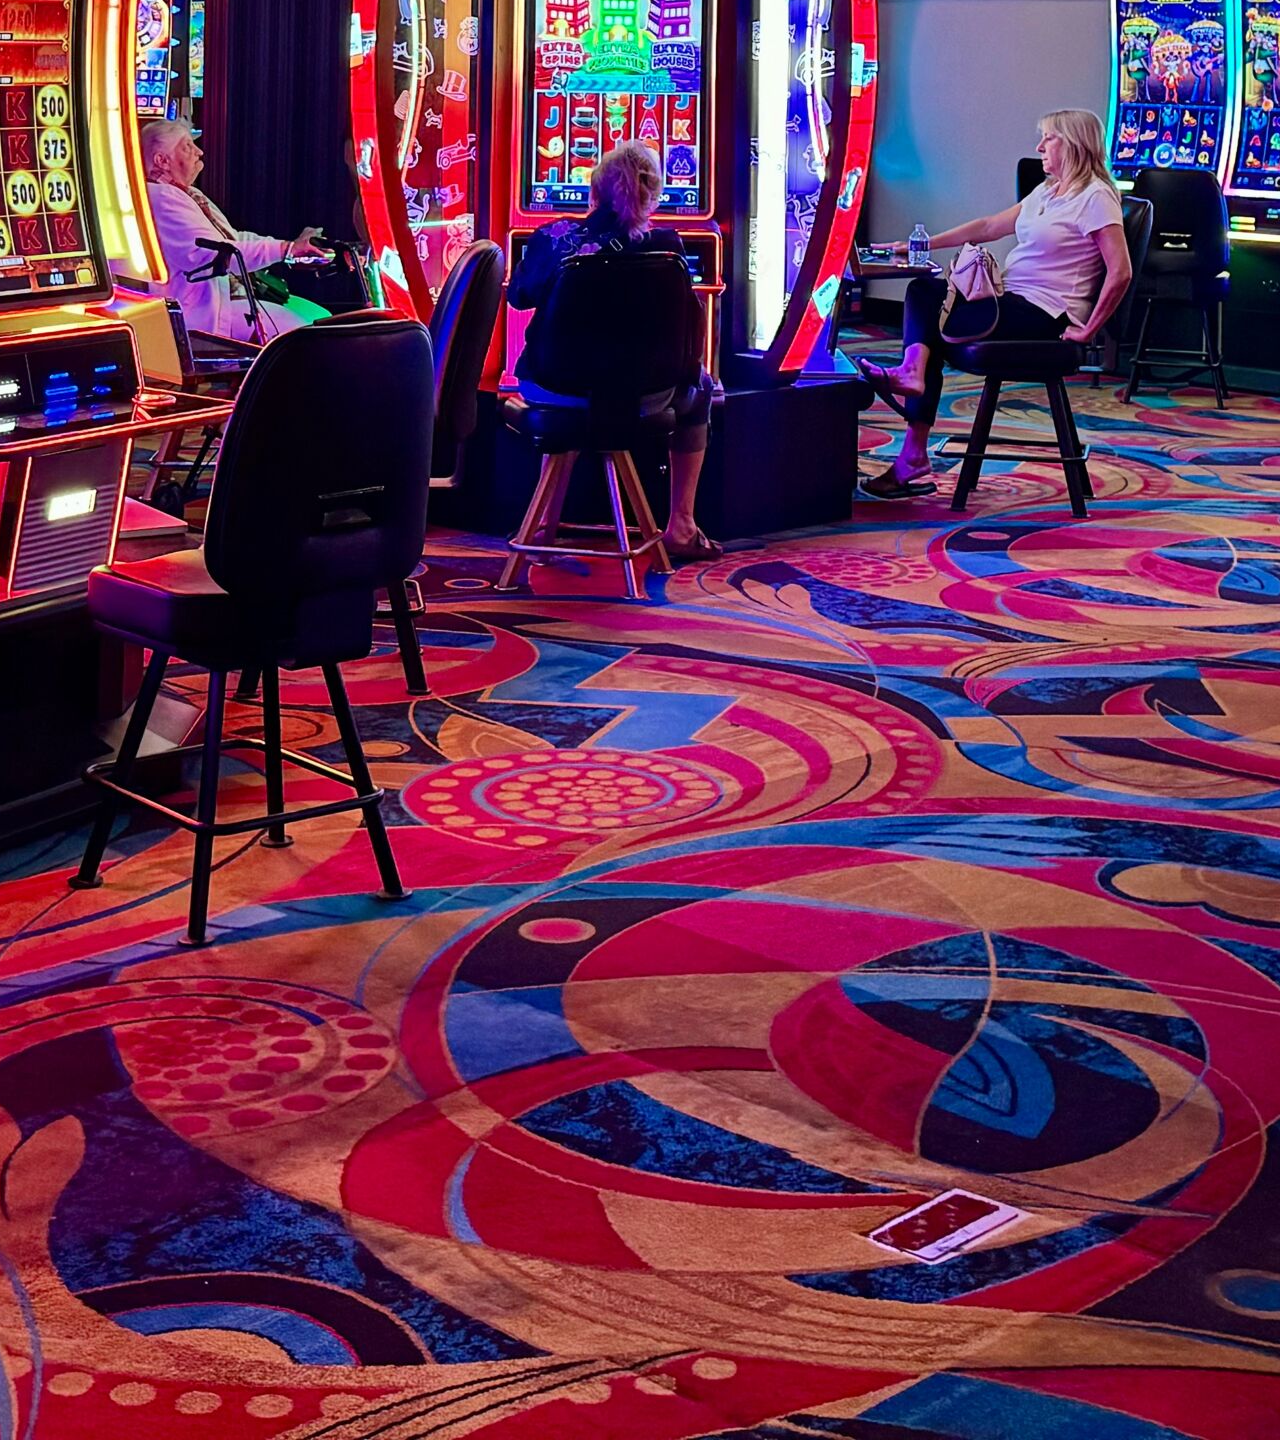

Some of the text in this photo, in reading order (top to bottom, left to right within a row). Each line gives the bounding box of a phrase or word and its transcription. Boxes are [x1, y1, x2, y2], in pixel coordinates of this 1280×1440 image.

[542, 42, 583, 54] EXTRA
[652, 43, 694, 55] EXTRA
[544, 55, 582, 67] SPINS
[652, 56, 695, 68] HOUSES
[6, 92, 28, 121] K
[41, 96, 64, 118] 500
[672, 118, 690, 140] K
[43, 139, 67, 161] 375
[12, 181, 36, 205] 500
[48, 180, 71, 203] 250
